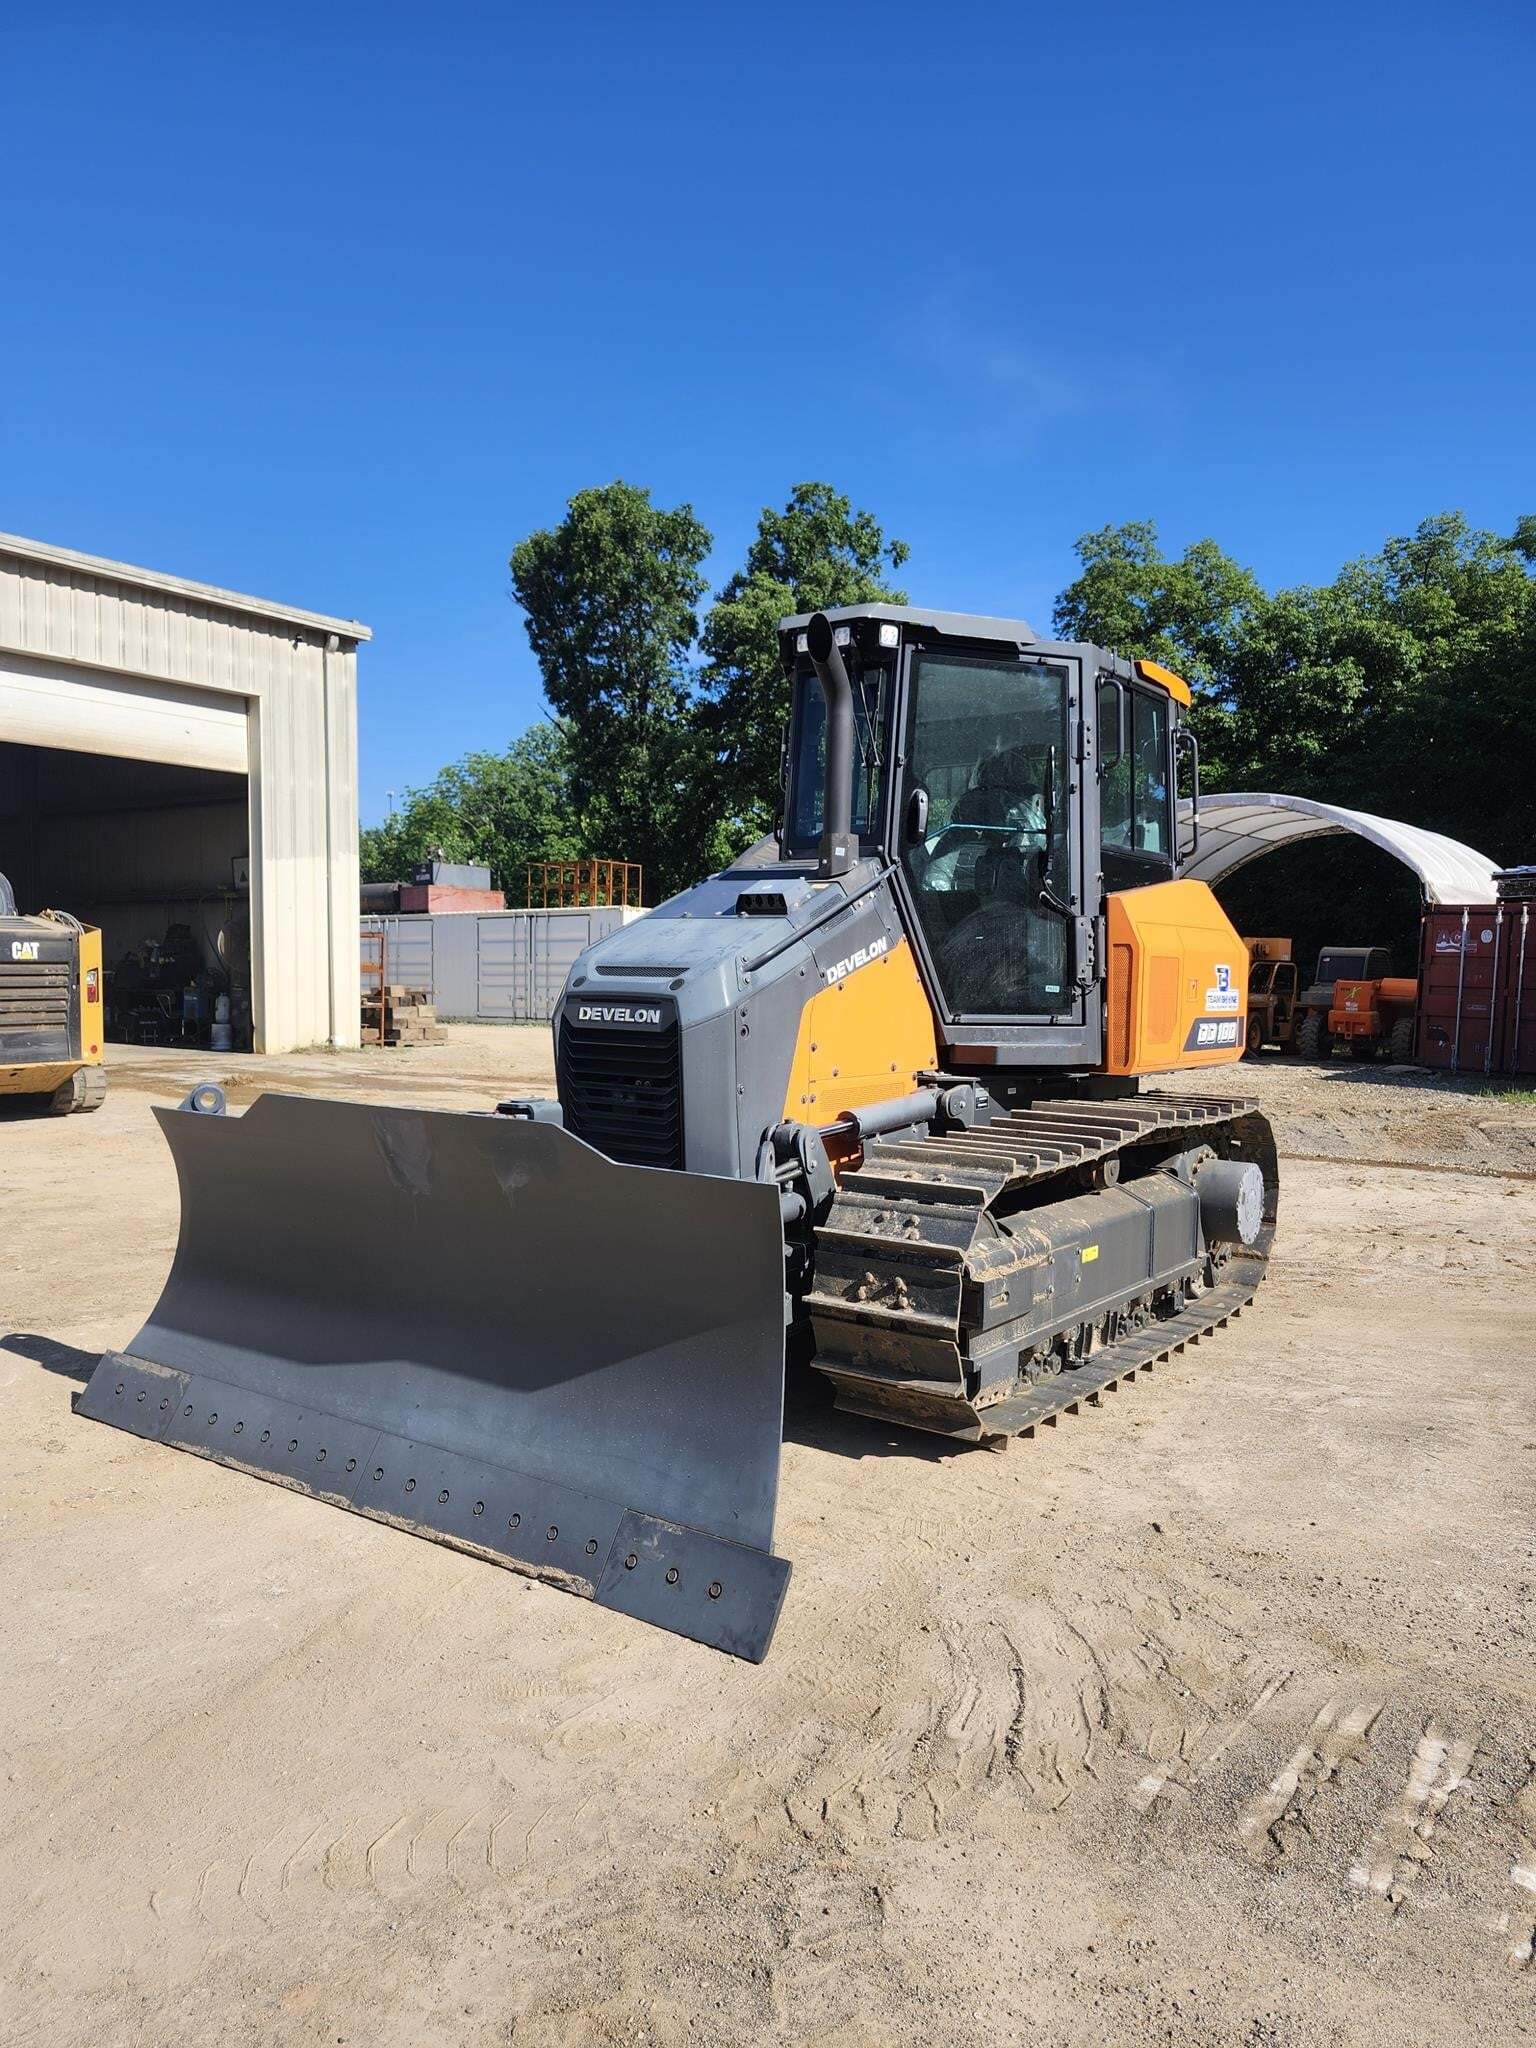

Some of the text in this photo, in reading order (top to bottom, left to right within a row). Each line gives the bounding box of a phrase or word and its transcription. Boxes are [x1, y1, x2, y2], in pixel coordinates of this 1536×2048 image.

[12, 942, 39, 960] CAT
[828, 937, 887, 985] DEVELON
[578, 1006, 661, 1024] DEVELON
